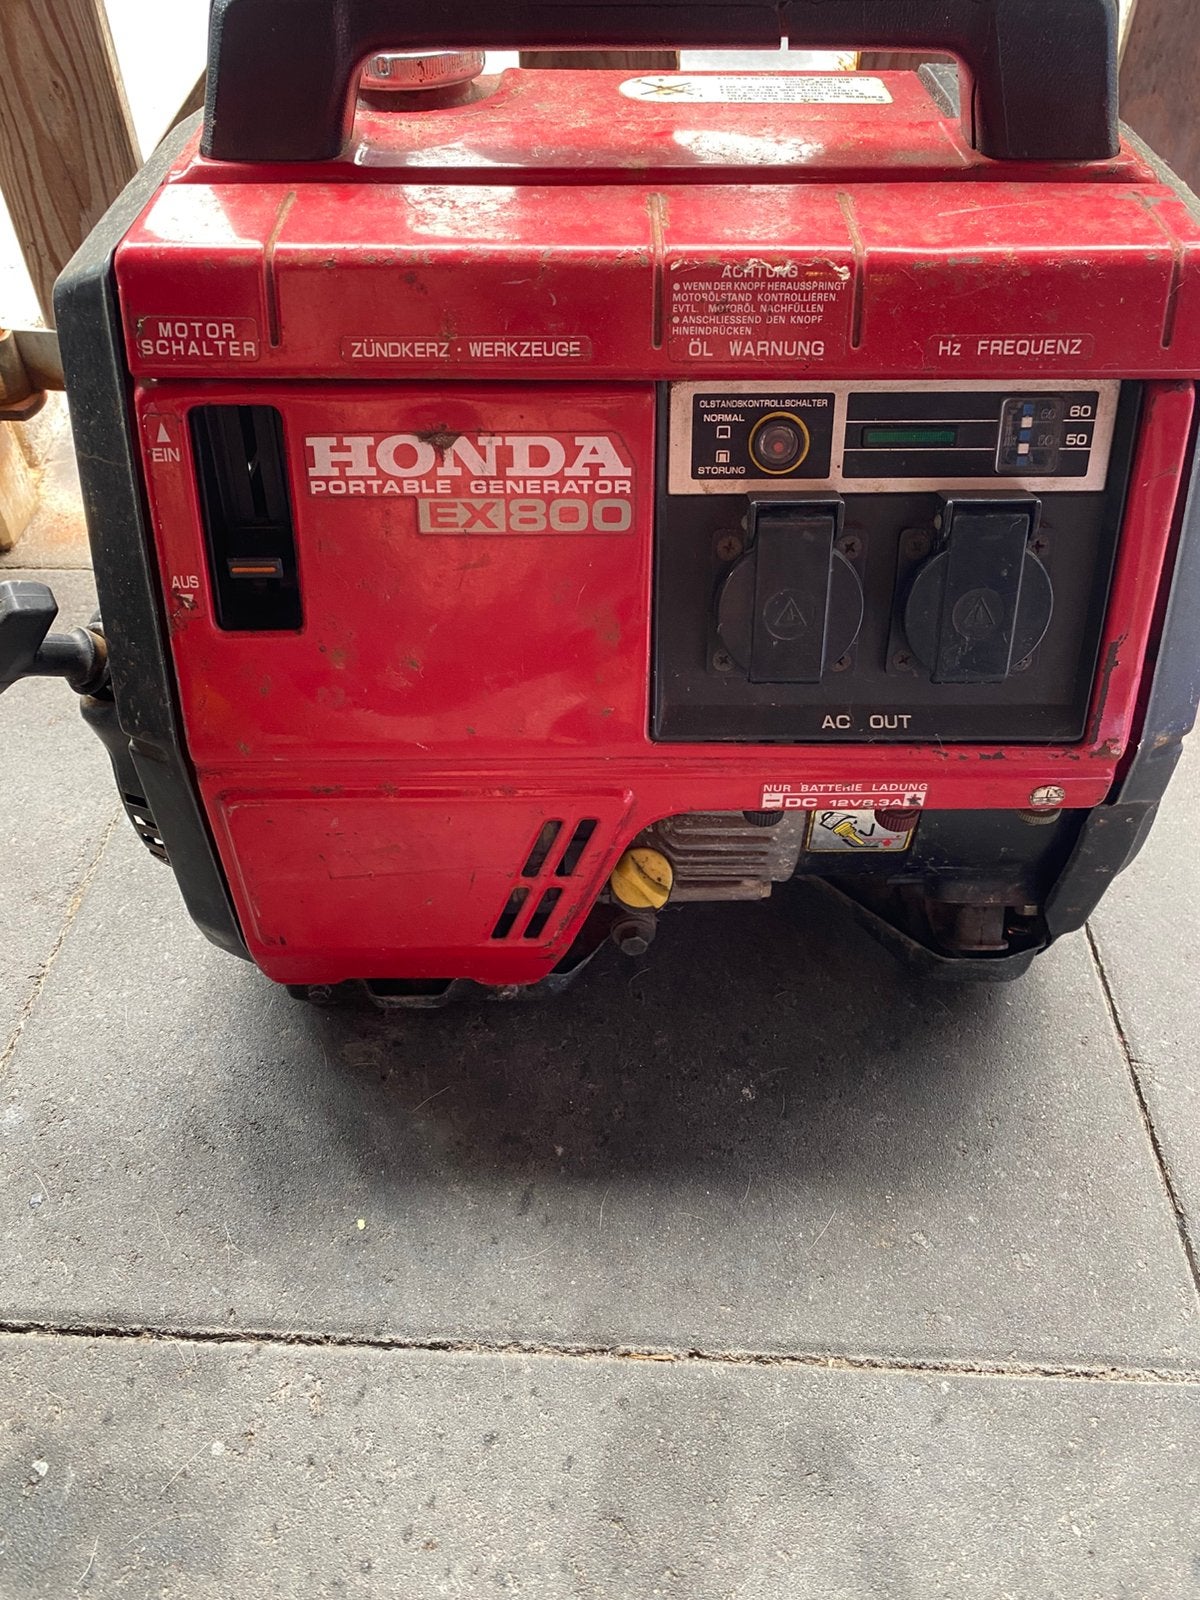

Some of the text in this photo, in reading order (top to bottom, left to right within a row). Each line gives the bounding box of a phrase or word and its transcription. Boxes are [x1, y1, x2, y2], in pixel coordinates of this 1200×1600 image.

[683, 281, 847, 291] WENN DER KNOPF HERAUSSPRINGT
[672, 292, 752, 302] MOTORÖLSTAND
[708, 303, 756, 313] MOTORÖL
[760, 303, 824, 313] NACHFÜLLEN
[682, 316, 823, 325] ANSCHLIESSEND DEN KNOPF
[158, 322, 236, 339] MOTOR
[672, 326, 752, 336] HINEINDRÜCKEN
[141, 340, 256, 357] SCHALTER
[351, 339, 580, 358] ZÜNDKERZ WERKZEUGE
[688, 338, 825, 357] ÖL WARNUNG
[938, 339, 1082, 356] Hz FREQUENZ
[703, 413, 745, 422] NORMAL
[1069, 405, 1092, 417] 60
[1065, 433, 1088, 446] 50
[152, 448, 180, 462] EIN
[305, 436, 632, 477] HONDA
[310, 480, 632, 494] PORTABLE GENERATOR
[419, 498, 632, 533] EX800
[171, 575, 200, 589] AUS
[821, 714, 912, 729] AC OUT
[763, 783, 928, 792] NUR BATTERIE LADUNG
[785, 798, 817, 807] DC
